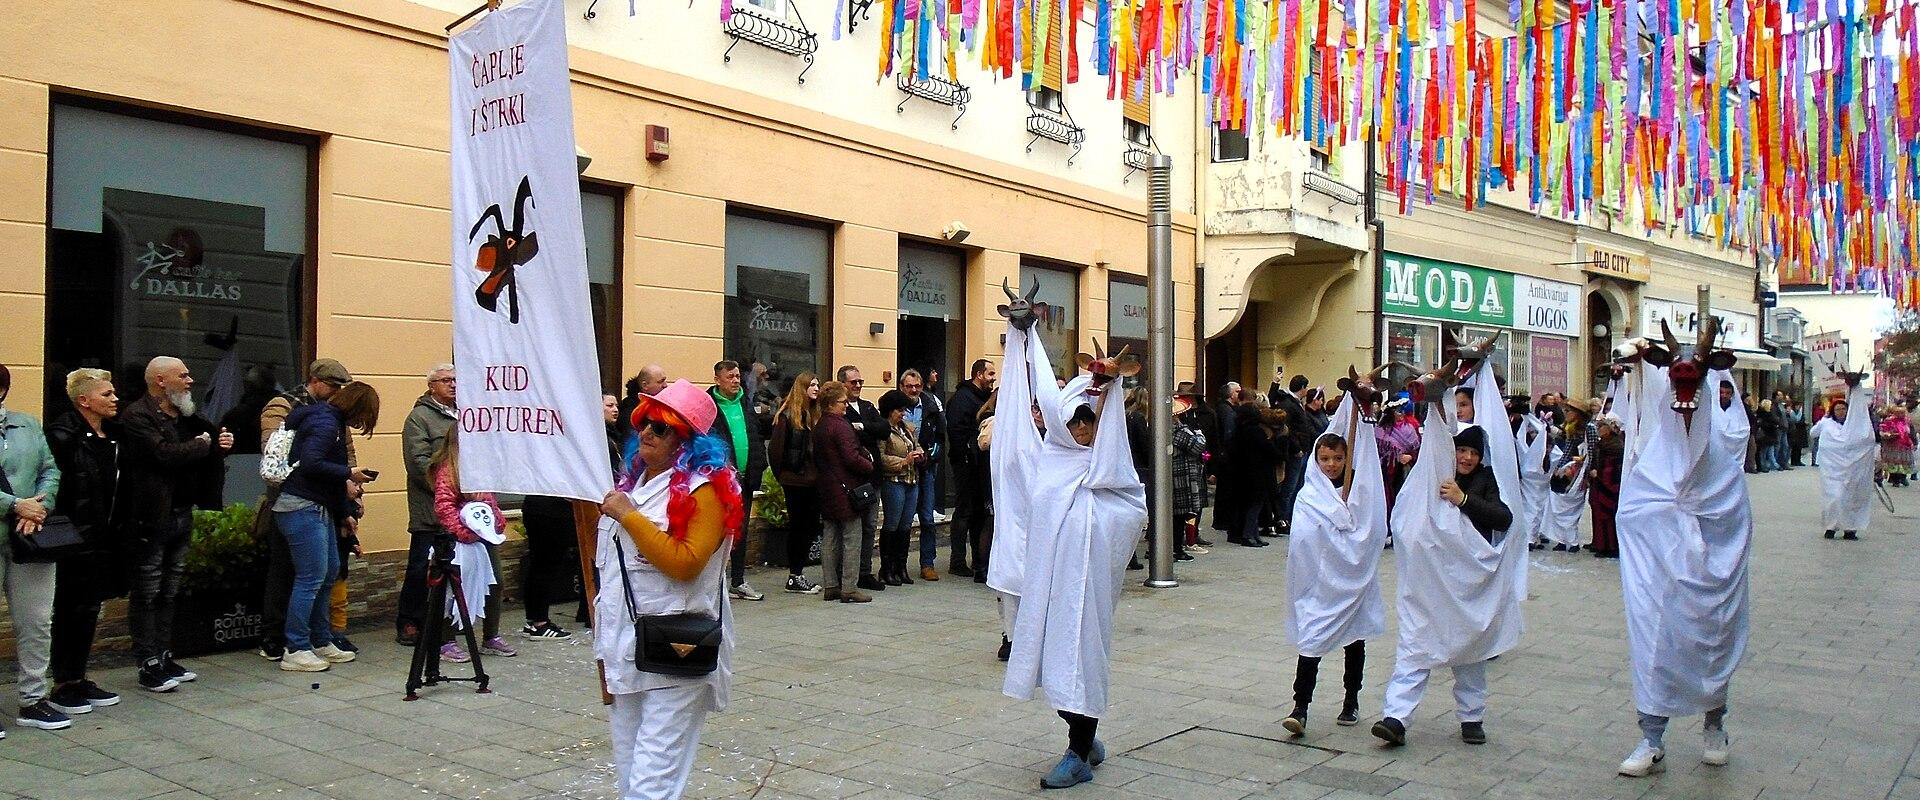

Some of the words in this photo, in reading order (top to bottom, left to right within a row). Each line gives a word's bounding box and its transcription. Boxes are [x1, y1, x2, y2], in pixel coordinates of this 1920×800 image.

[471, 44, 525, 89] ČAPLJE
[470, 108, 477, 137] I
[481, 93, 526, 132] ŠTRKI
[1594, 250, 1609, 269] OLD
[1611, 254, 1631, 273] CITY
[145, 278, 242, 301] DALLAS
[907, 290, 946, 306] DALLAS
[1385, 259, 1504, 317] MODA
[755, 319, 798, 333] DALLAS
[1527, 305, 1568, 331] LOGOS
[485, 365, 529, 392] KUD
[214, 625, 262, 643] QUELLE
